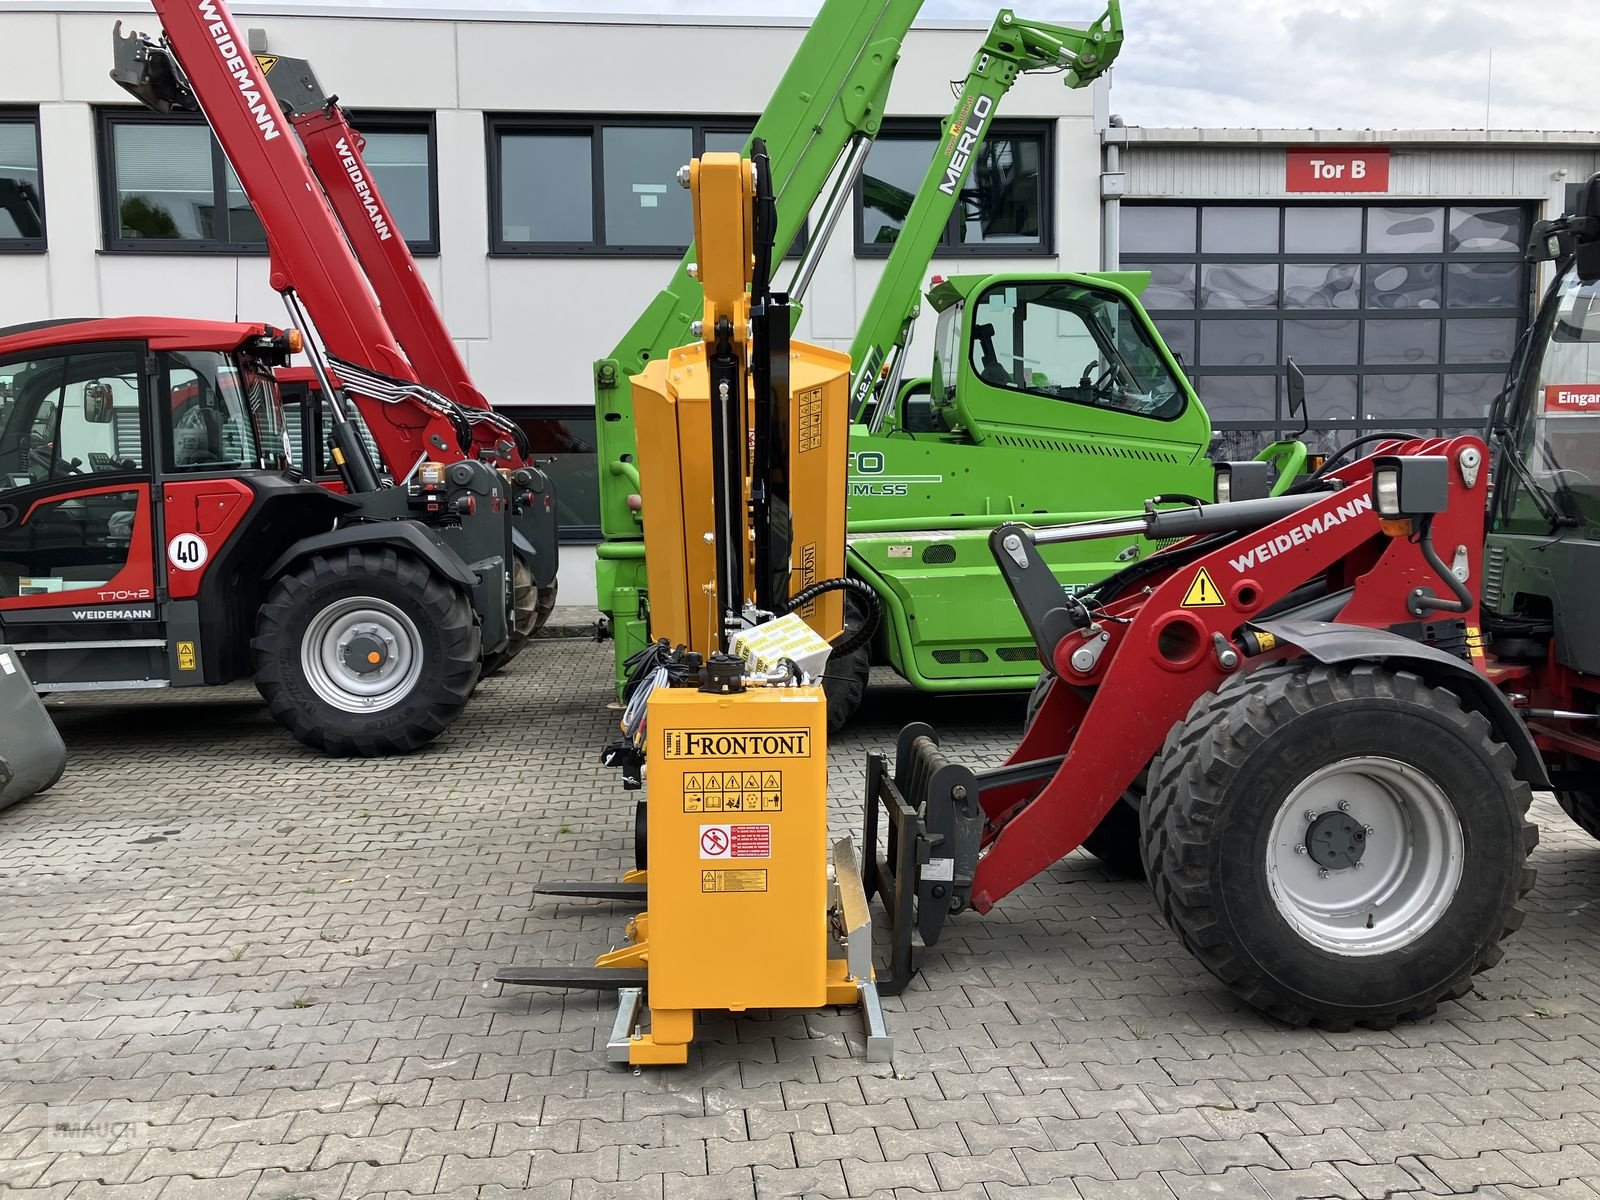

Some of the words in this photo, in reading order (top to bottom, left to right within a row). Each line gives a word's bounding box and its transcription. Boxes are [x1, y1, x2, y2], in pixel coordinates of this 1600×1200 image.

[198, 0, 280, 140] WEIDEMANN
[939, 95, 993, 196] MERLO
[1310, 160, 1345, 179] Tor
[1351, 160, 1366, 179] B
[335, 136, 392, 241] WEIDEMANN
[856, 369, 873, 402] 42.7
[1228, 493, 1373, 573] WEIDEMANN
[177, 540, 198, 563] 40
[97, 588, 150, 600] T7042
[72, 609, 152, 620] WEIDEMANN
[684, 730, 809, 756] FRONTONI
